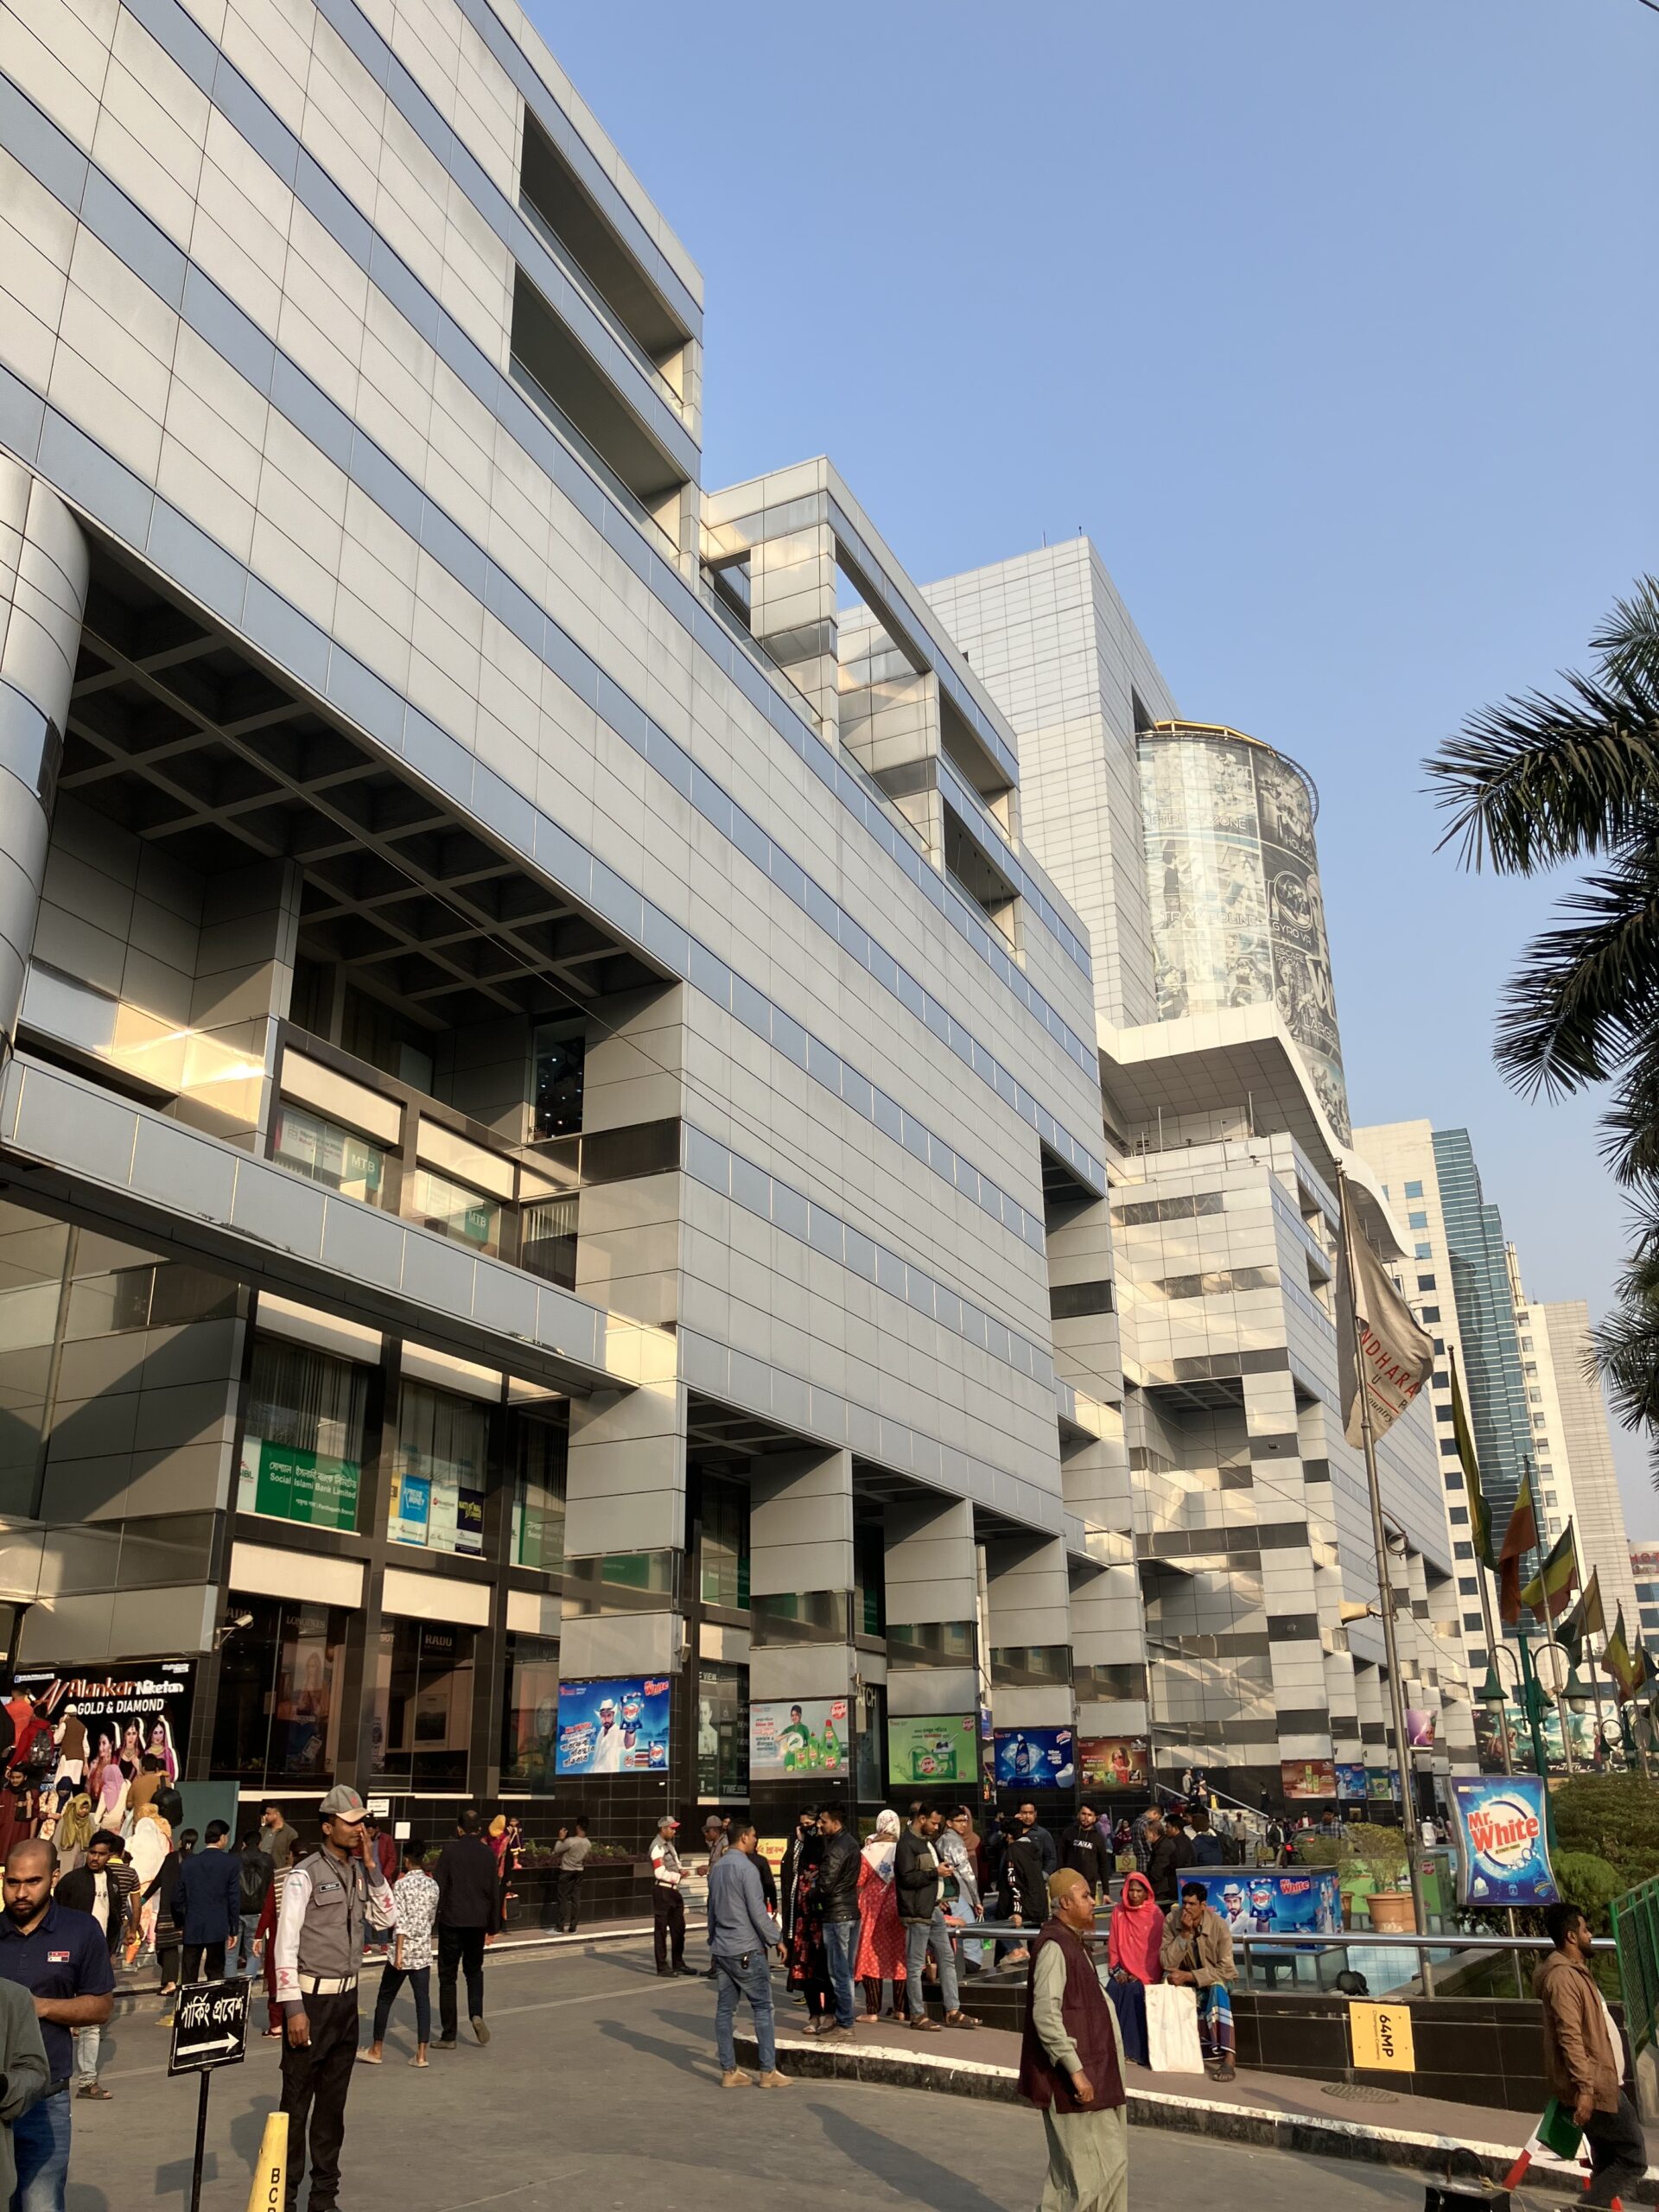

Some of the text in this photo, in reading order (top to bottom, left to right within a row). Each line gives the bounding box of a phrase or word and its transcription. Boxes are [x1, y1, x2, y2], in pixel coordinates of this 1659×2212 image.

[1210, 814, 1247, 830] ZONE
[1160, 910, 1258, 927] TRAMPOLINE
[1272, 921, 1313, 946] GYRO VR
[1274, 945, 1306, 963] ESCAPE
[1275, 954, 1299, 968] ROOM
[352, 1154, 375, 1173] MTB
[469, 1211, 486, 1227] MTB
[270, 1472, 356, 1499] Social Islami Bank Limited
[286, 1615, 326, 1629] LONGINES
[425, 1634, 453, 1647] RADO
[67, 1677, 137, 1698] Alankar
[136, 1680, 184, 1695] Niketan
[78, 1699, 164, 1714] GOLD & DIAMOND
[1468, 1812, 1493, 1830] Mr.
[1470, 1817, 1539, 1852] White
[1281, 1880, 1310, 1894] White
[1379, 2014, 1394, 2057] 64MP
